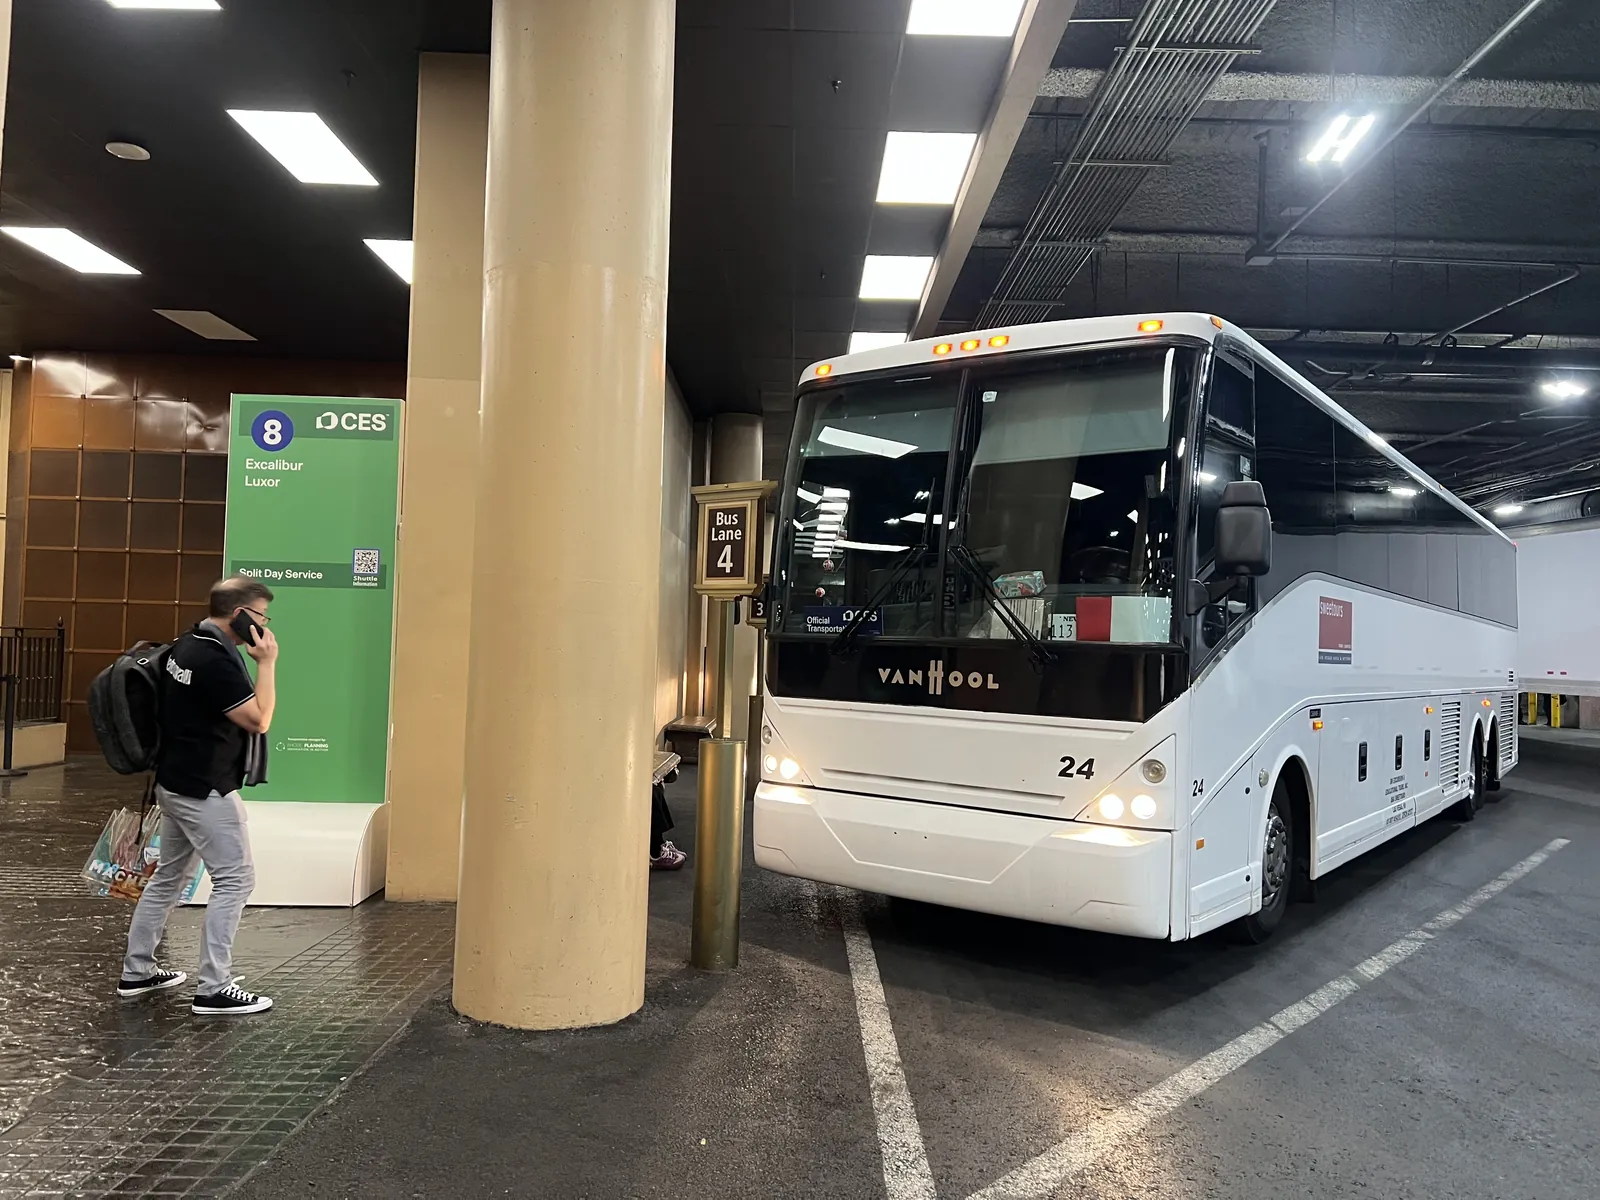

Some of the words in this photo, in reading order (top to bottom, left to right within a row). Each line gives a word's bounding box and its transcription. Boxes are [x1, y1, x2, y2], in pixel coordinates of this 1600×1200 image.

[341, 413, 386, 431] CES
[263, 419, 282, 445] 8
[245, 458, 303, 471] Excalibur
[245, 475, 280, 487] Luxor
[716, 512, 738, 525] Bus
[712, 527, 742, 541] Lane
[717, 544, 733, 573] 4
[239, 568, 262, 578] Split
[264, 569, 283, 580] Day
[285, 570, 323, 579] Service
[756, 602, 764, 616] 3
[807, 616, 830, 624] Official
[1058, 755, 1095, 779] 24
[1192, 779, 1204, 797] 24
